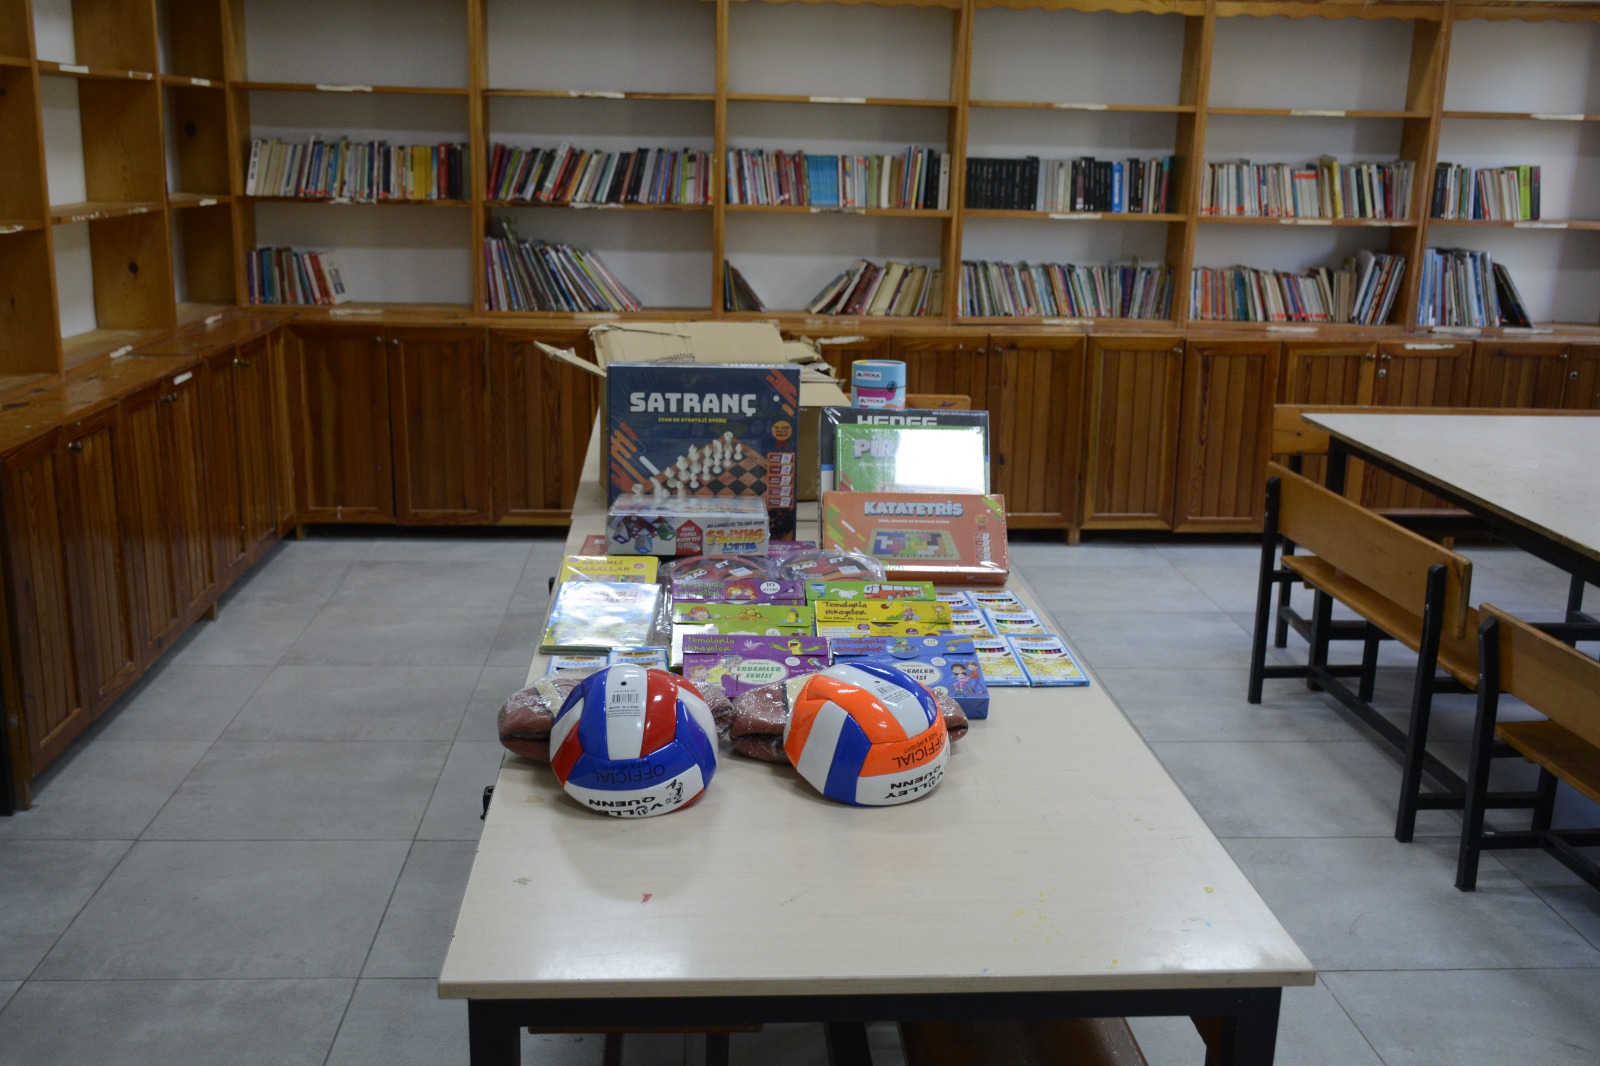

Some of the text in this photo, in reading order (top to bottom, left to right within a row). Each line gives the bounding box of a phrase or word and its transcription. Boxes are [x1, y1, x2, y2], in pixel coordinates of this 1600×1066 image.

[630, 392, 757, 417] SATRANÇ
[864, 500, 964, 517] KATATETRİS
[891, 732, 944, 769] OFFICIAL
[592, 764, 666, 784] OFFICIAL
[884, 771, 944, 799] VOLLEY
[890, 765, 941, 789] QUENN
[588, 797, 656, 808] QUENN
